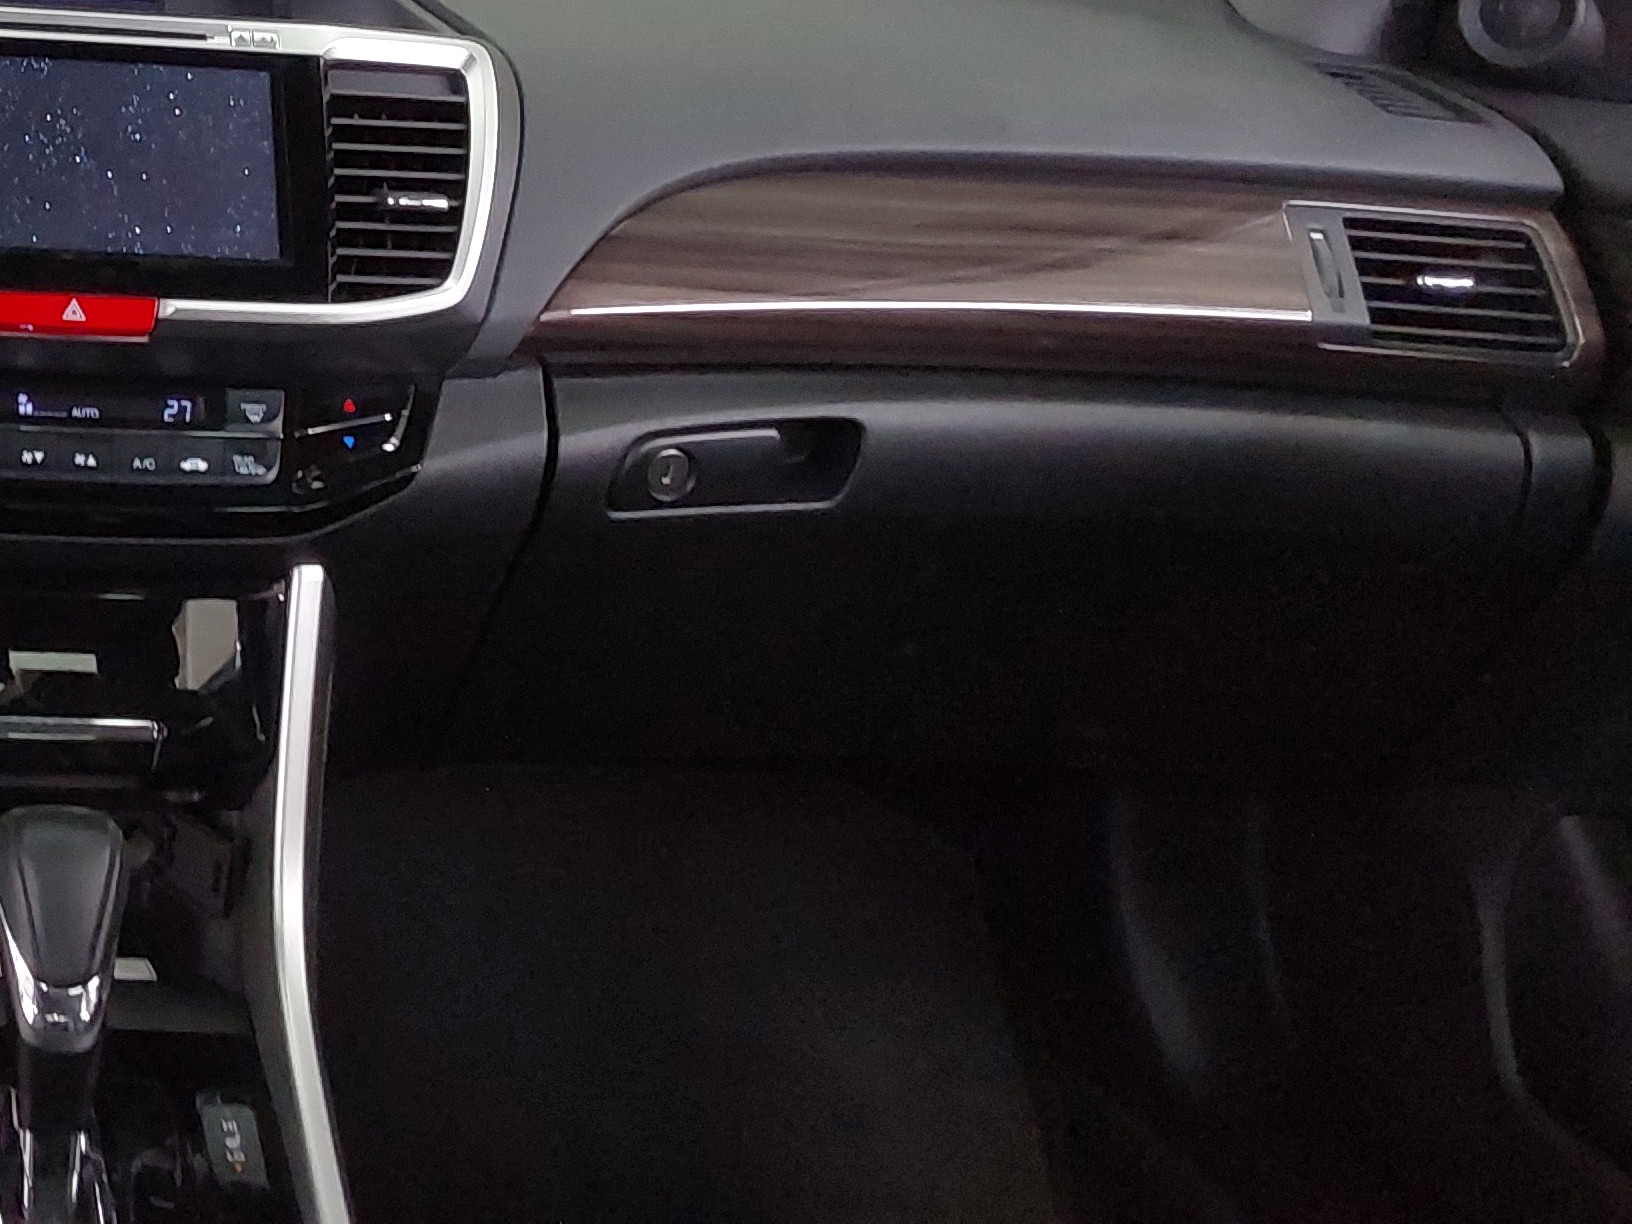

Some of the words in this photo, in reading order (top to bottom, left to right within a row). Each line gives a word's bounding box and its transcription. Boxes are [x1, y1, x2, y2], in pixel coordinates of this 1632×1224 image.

[71, 406, 100, 419] AUTO
[163, 400, 193, 423] 27
[132, 456, 156, 471] A/C
